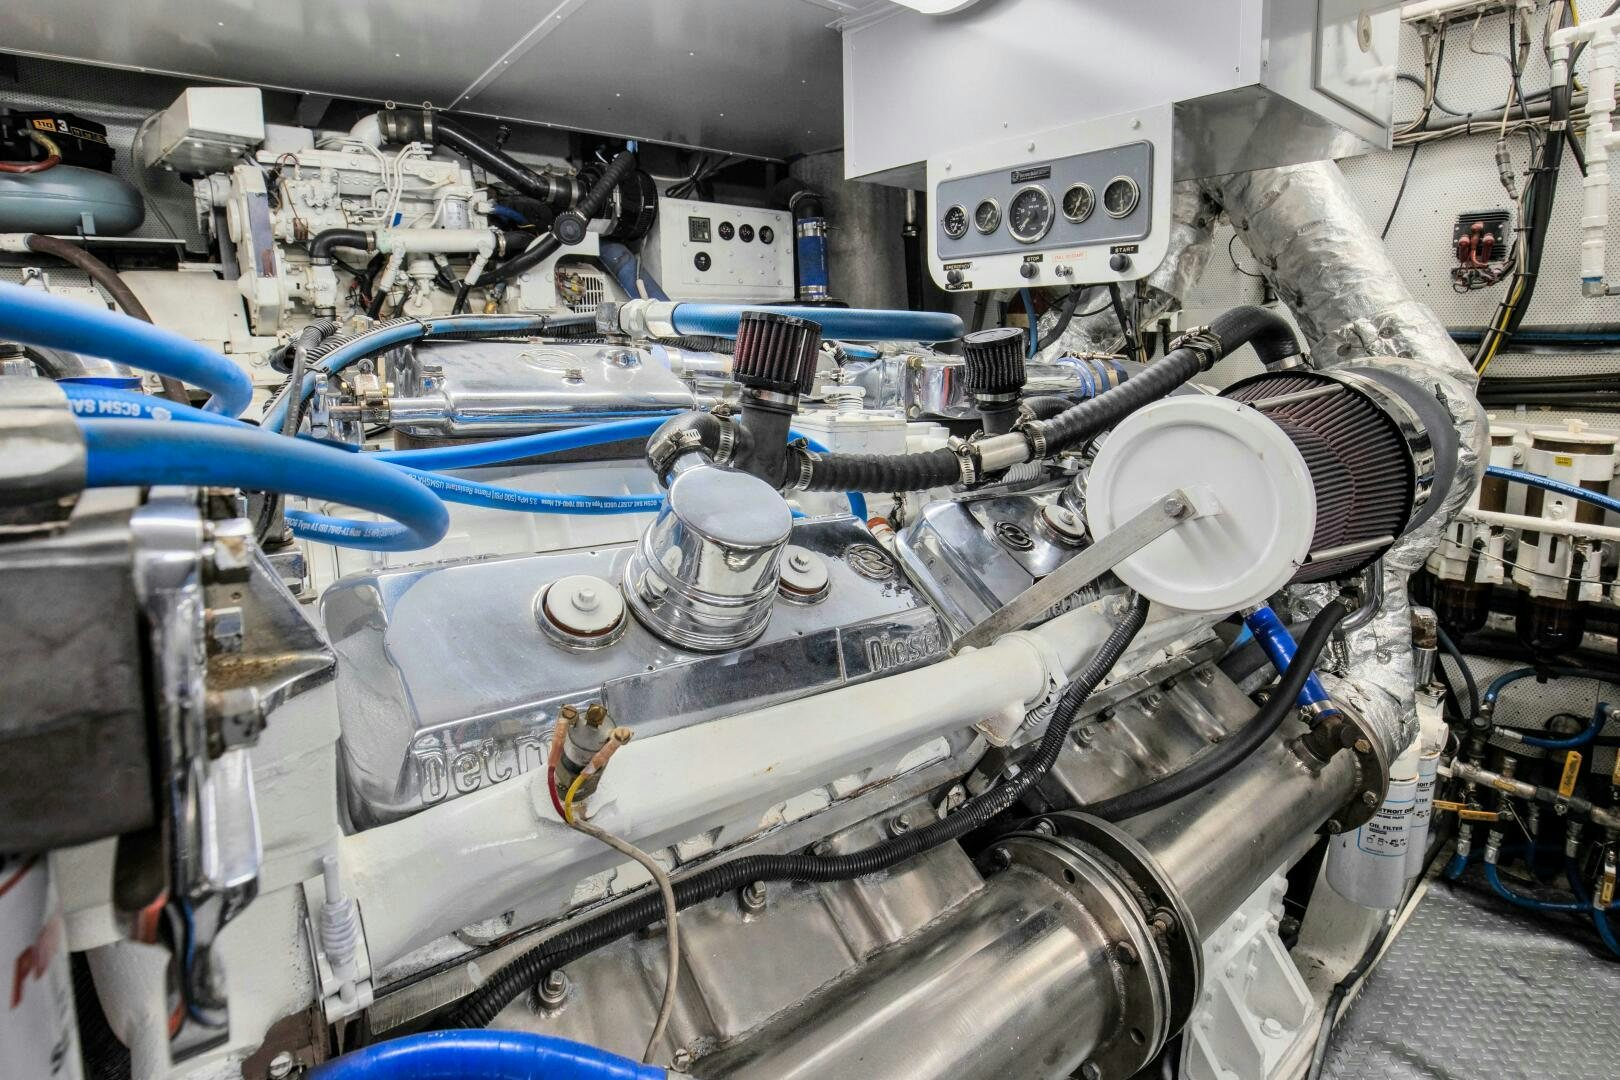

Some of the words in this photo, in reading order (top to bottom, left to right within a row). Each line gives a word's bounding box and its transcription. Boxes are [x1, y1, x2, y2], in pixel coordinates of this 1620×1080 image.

[1114, 246, 1135, 254] START
[445, 482, 474, 495] Resistant
[473, 487, 491, 498] Flame
[420, 732, 546, 805] Detr
